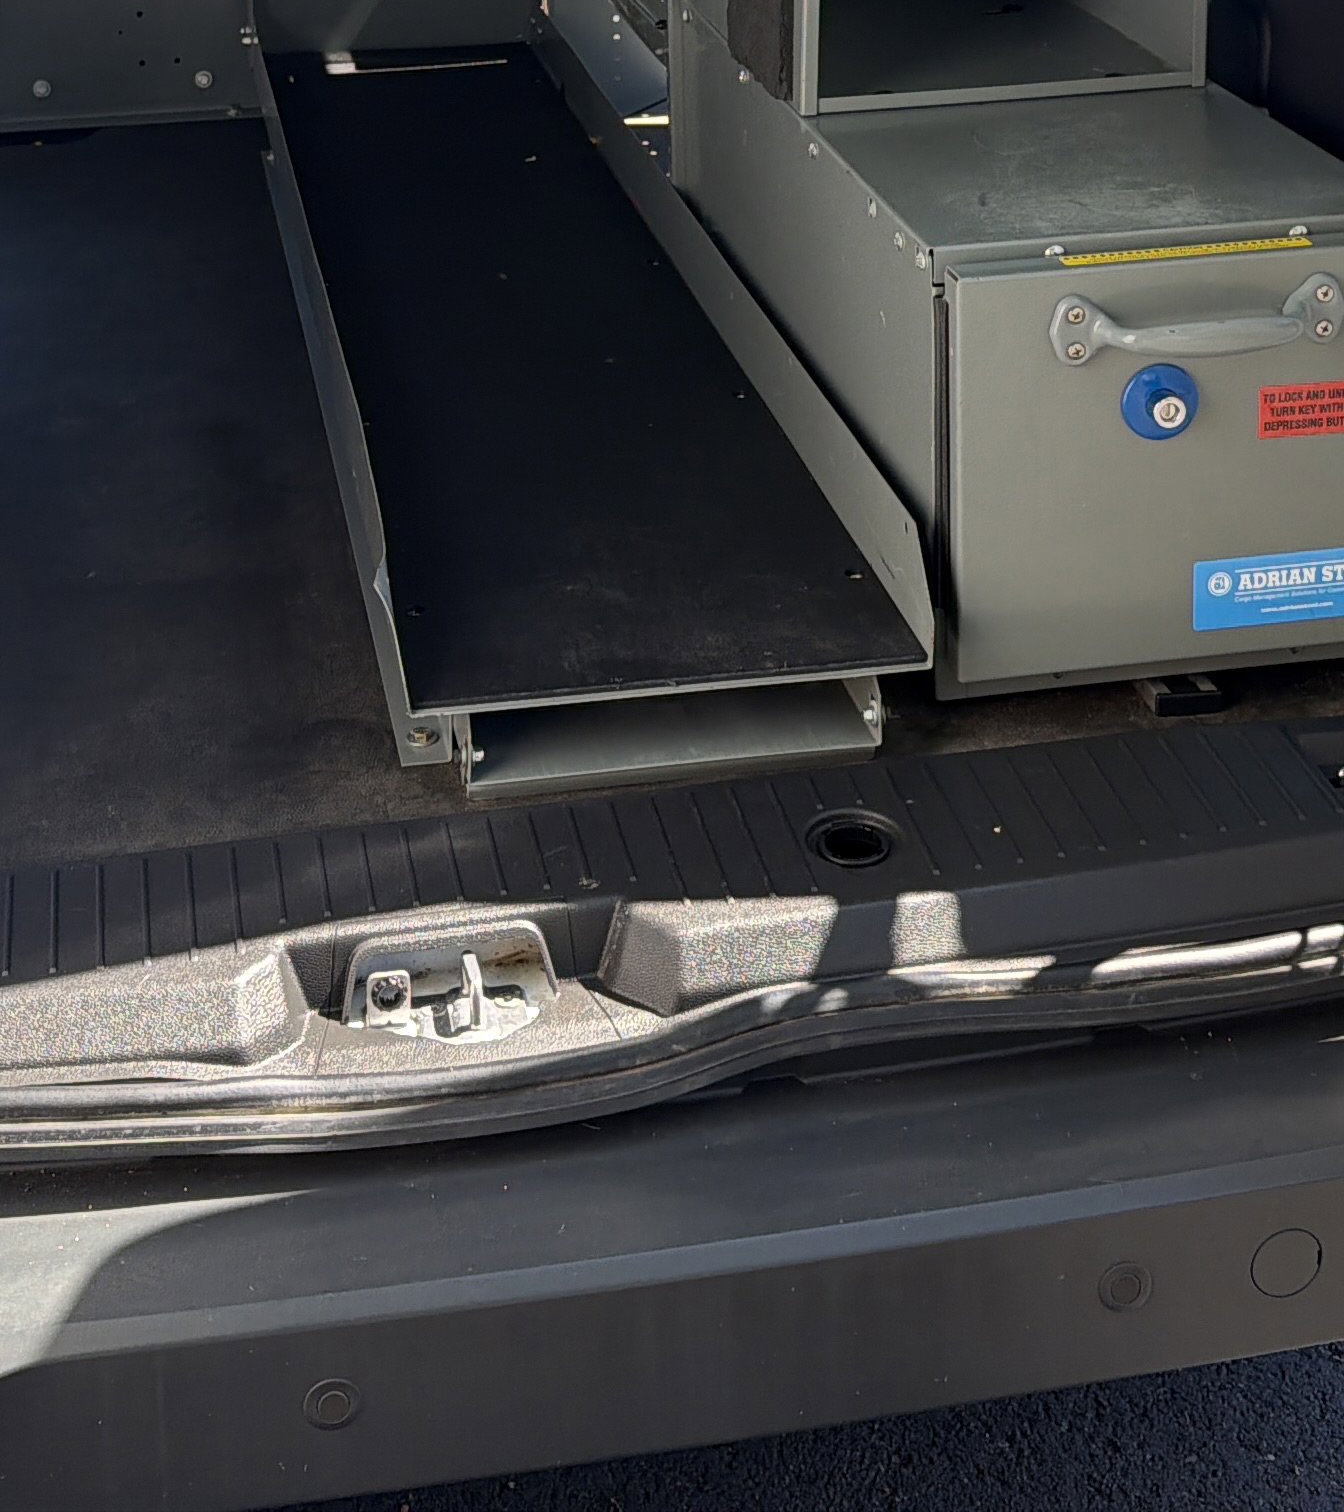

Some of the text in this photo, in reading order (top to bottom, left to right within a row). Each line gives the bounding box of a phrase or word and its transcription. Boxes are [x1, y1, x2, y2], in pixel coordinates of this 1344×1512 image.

[1263, 393, 1276, 404] TO
[1278, 391, 1304, 403] LOCK
[1306, 389, 1326, 400] AND
[1270, 406, 1296, 417] TURN
[1298, 404, 1317, 415] KEY
[1263, 417, 1324, 432] DEPRESSING
[1237, 566, 1316, 591] ADRIAN
